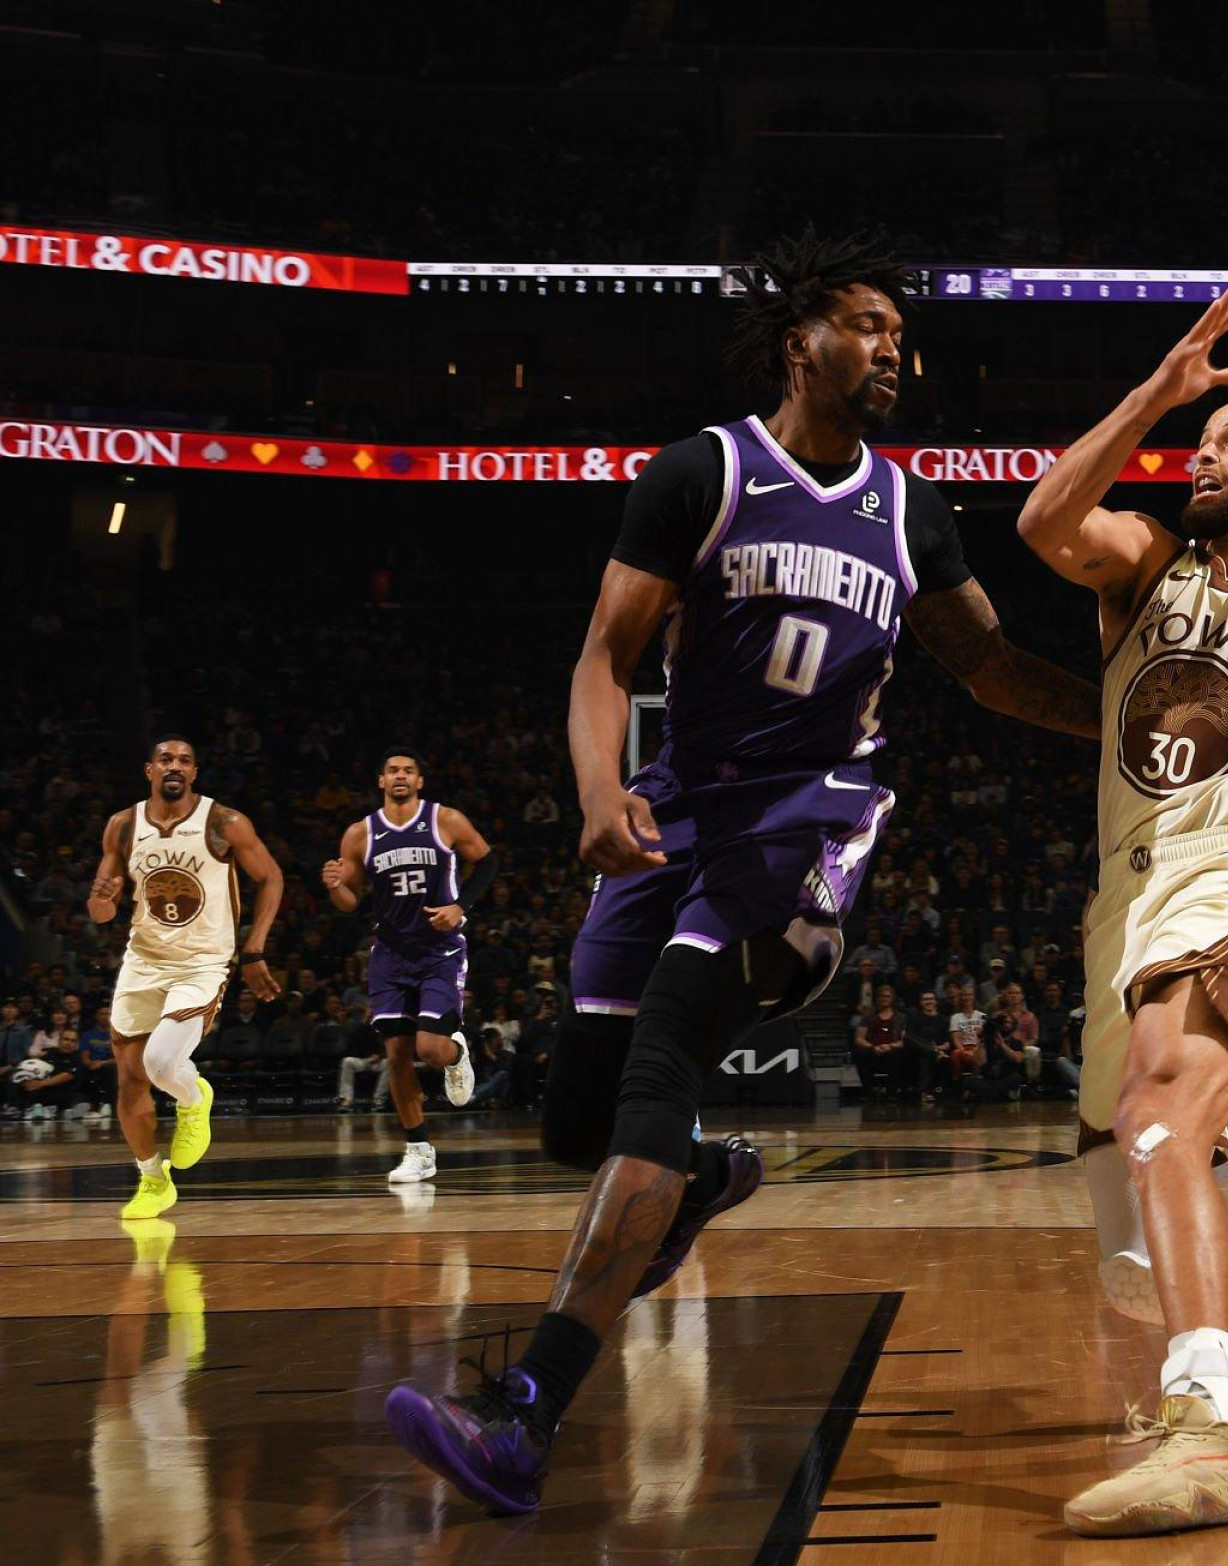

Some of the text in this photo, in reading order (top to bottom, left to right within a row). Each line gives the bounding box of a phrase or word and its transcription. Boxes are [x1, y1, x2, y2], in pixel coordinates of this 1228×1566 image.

[91, 235, 131, 272] &
[139, 244, 312, 287] CASINO
[458, 279, 470, 292] 2
[497, 279, 508, 292] 7
[575, 280, 587, 293] 2
[614, 280, 626, 293] 2
[945, 273, 972, 294] 20
[1024, 283, 1035, 297] 3
[1062, 284, 1073, 297] 3
[1099, 284, 1110, 298] 6
[1136, 285, 1147, 299] 2
[1173, 285, 1185, 299] 2
[0, 421, 181, 466] GRATON
[438, 452, 578, 481] HOTEL
[580, 447, 618, 481] &
[721, 541, 896, 631] SACRAMENTO
[1145, 598, 1173, 620] The
[765, 614, 830, 697] 0
[1141, 731, 1196, 785] 30
[135, 849, 205, 875] TOWN
[373, 846, 438, 875] SACRAMENTO
[389, 869, 428, 897] 32
[164, 902, 180, 921] 8
